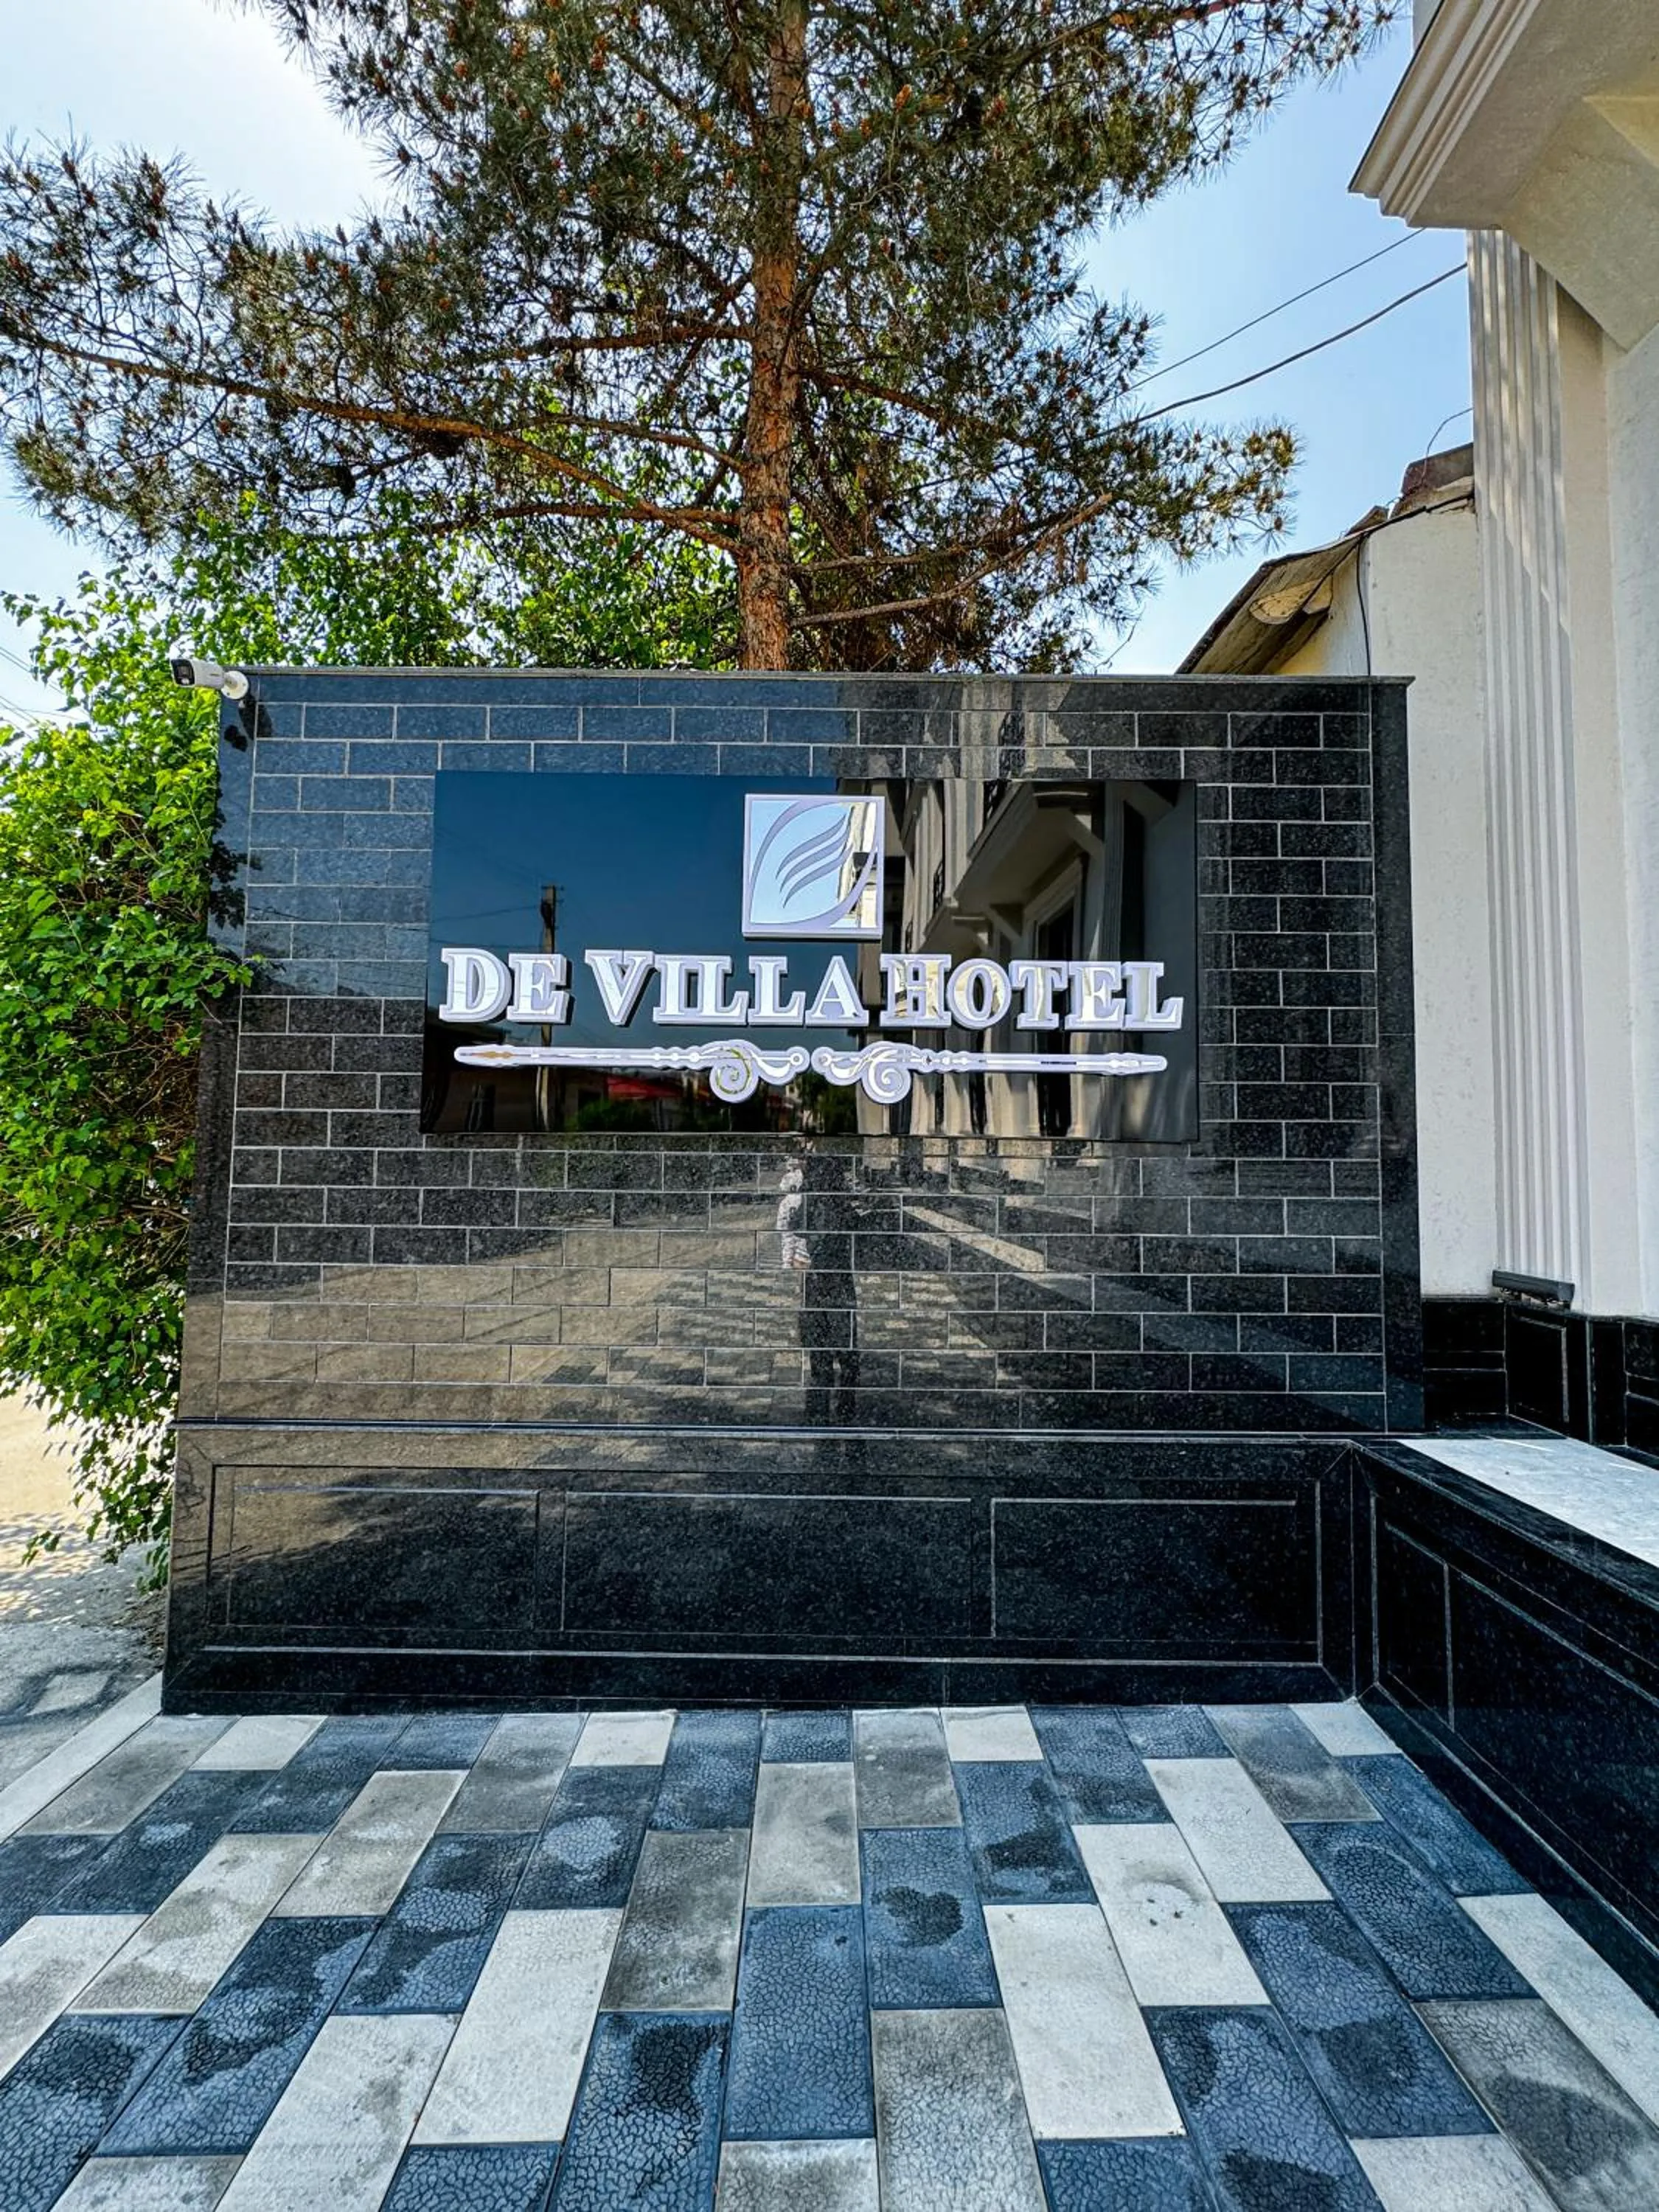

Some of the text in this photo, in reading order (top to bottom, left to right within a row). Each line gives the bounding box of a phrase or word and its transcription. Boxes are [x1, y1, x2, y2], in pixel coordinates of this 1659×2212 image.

[439, 947, 1183, 1032] DE VILLA HOTEL
